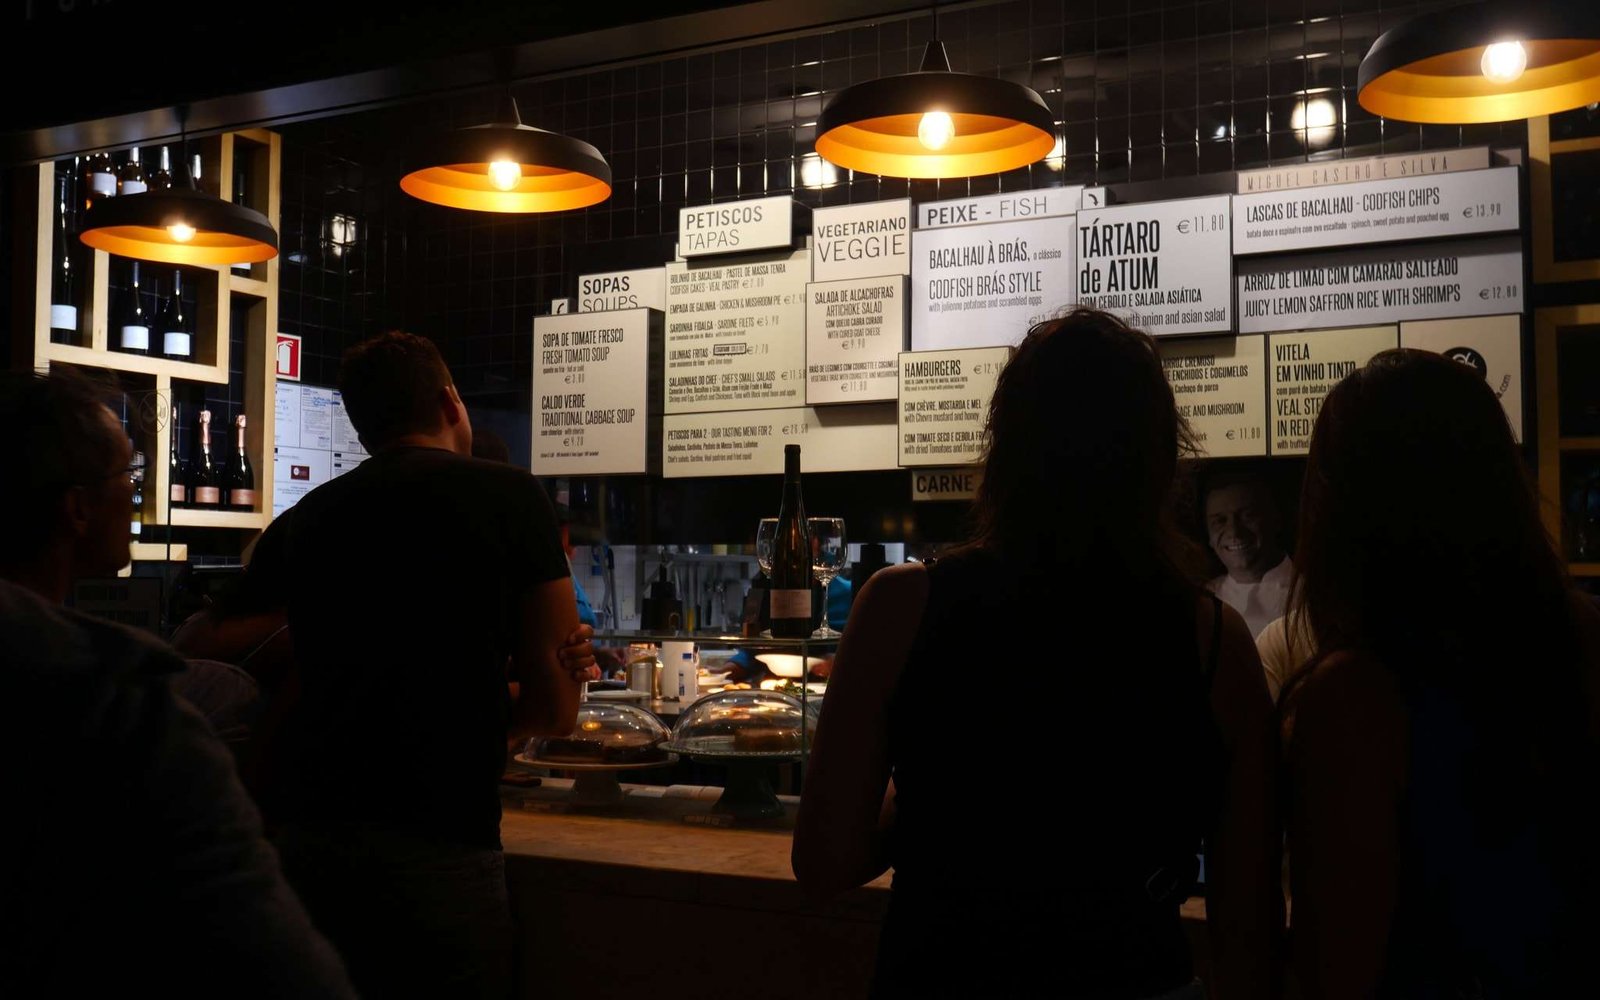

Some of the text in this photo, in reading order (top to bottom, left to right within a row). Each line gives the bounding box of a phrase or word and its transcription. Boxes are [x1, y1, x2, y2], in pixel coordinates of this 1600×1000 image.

[1248, 156, 1448, 192] MIGUEL CASTRO E SILVA
[928, 196, 1047, 226] PEIXE FISH
[1247, 204, 1284, 223] LASCAS
[1286, 202, 1298, 219] DE
[1302, 196, 1353, 218] BACALHAU
[1363, 191, 1406, 212] CODFISH
[1408, 187, 1440, 208] CHIPS
[686, 206, 762, 230] PETISCOS
[818, 216, 906, 238] VEGETARIANO
[1176, 214, 1224, 234] €11.80
[686, 229, 740, 250] TAPAS
[1080, 217, 1160, 258] TÁRTARO
[818, 234, 905, 262] VEGGIE
[930, 246, 984, 270] BACALHAU
[988, 240, 995, 264] À
[1038, 249, 1061, 260] clássico
[1080, 256, 1158, 294] de ATUM
[1244, 274, 1276, 292] ARROZ
[1278, 272, 1291, 289] DE
[1328, 266, 1350, 286] COM
[1352, 260, 1403, 283] CAMARÃO
[1406, 257, 1458, 280] SALTEADO
[583, 276, 630, 295] SOPAS
[929, 270, 1042, 300] CODFISH BRÁS STYLE
[815, 286, 894, 304] SALADA DE ALCACHOFRAS
[929, 301, 940, 312] with
[988, 298, 998, 308] and
[999, 296, 1027, 308] scrambled
[1080, 286, 1202, 309] COM CEBOLO E SALADA ASIÁTICA
[1244, 299, 1270, 318] JUICY
[1273, 296, 1307, 316] LEMON
[1309, 293, 1354, 314] SAFFRON
[1356, 291, 1379, 309] RICE
[1382, 288, 1410, 308] WITH
[1412, 284, 1460, 305] SHRIMPS
[826, 300, 882, 317] ARTICHOKE SALAD
[1124, 307, 1226, 327] with onion and asian salad
[826, 320, 835, 328] COM
[850, 317, 864, 326] CABRA
[866, 316, 883, 325] CURADO
[543, 328, 624, 348] SOPA DE TOMATE FRESCO
[828, 330, 838, 339] WITH
[865, 327, 880, 336] CHEESE
[543, 346, 610, 364] FRESH TOMATO SOUP
[1184, 355, 1215, 367] CREMOSO
[1276, 343, 1310, 362] VITELA
[904, 360, 960, 378] HAMBURGERS
[1172, 365, 1248, 380] ENCHIDOS E COGUMELOS
[1276, 365, 1290, 382] EM
[1294, 363, 1324, 380] VINHO
[1276, 387, 1288, 396] com
[542, 394, 585, 410] CALDO VERDE
[904, 402, 915, 412] COM
[938, 400, 966, 410] MOSTARDA
[971, 399, 982, 409] MEL
[1192, 404, 1206, 416] AND
[1208, 402, 1244, 416] MUSHROOM
[1276, 398, 1302, 416] VEAL
[541, 408, 635, 427] TRADITIONAL CABBAGE SOUP
[904, 414, 915, 423] with
[933, 412, 953, 422] mustard
[954, 412, 964, 421] and
[964, 411, 979, 422] honey
[668, 425, 772, 440] PETISCOS PARA 2 OUR TASTING MENU FOR 2
[904, 433, 915, 443] COM
[916, 432, 936, 442] TOMATE
[937, 432, 950, 442] SECO
[950, 432, 954, 442] E
[955, 431, 974, 442] CEBOLA
[1277, 420, 1287, 437] IN
[1290, 418, 1308, 436] RED
[904, 444, 915, 454] with
[916, 444, 928, 454] dried
[1276, 440, 1288, 449] with
[916, 474, 974, 494] CARNE
